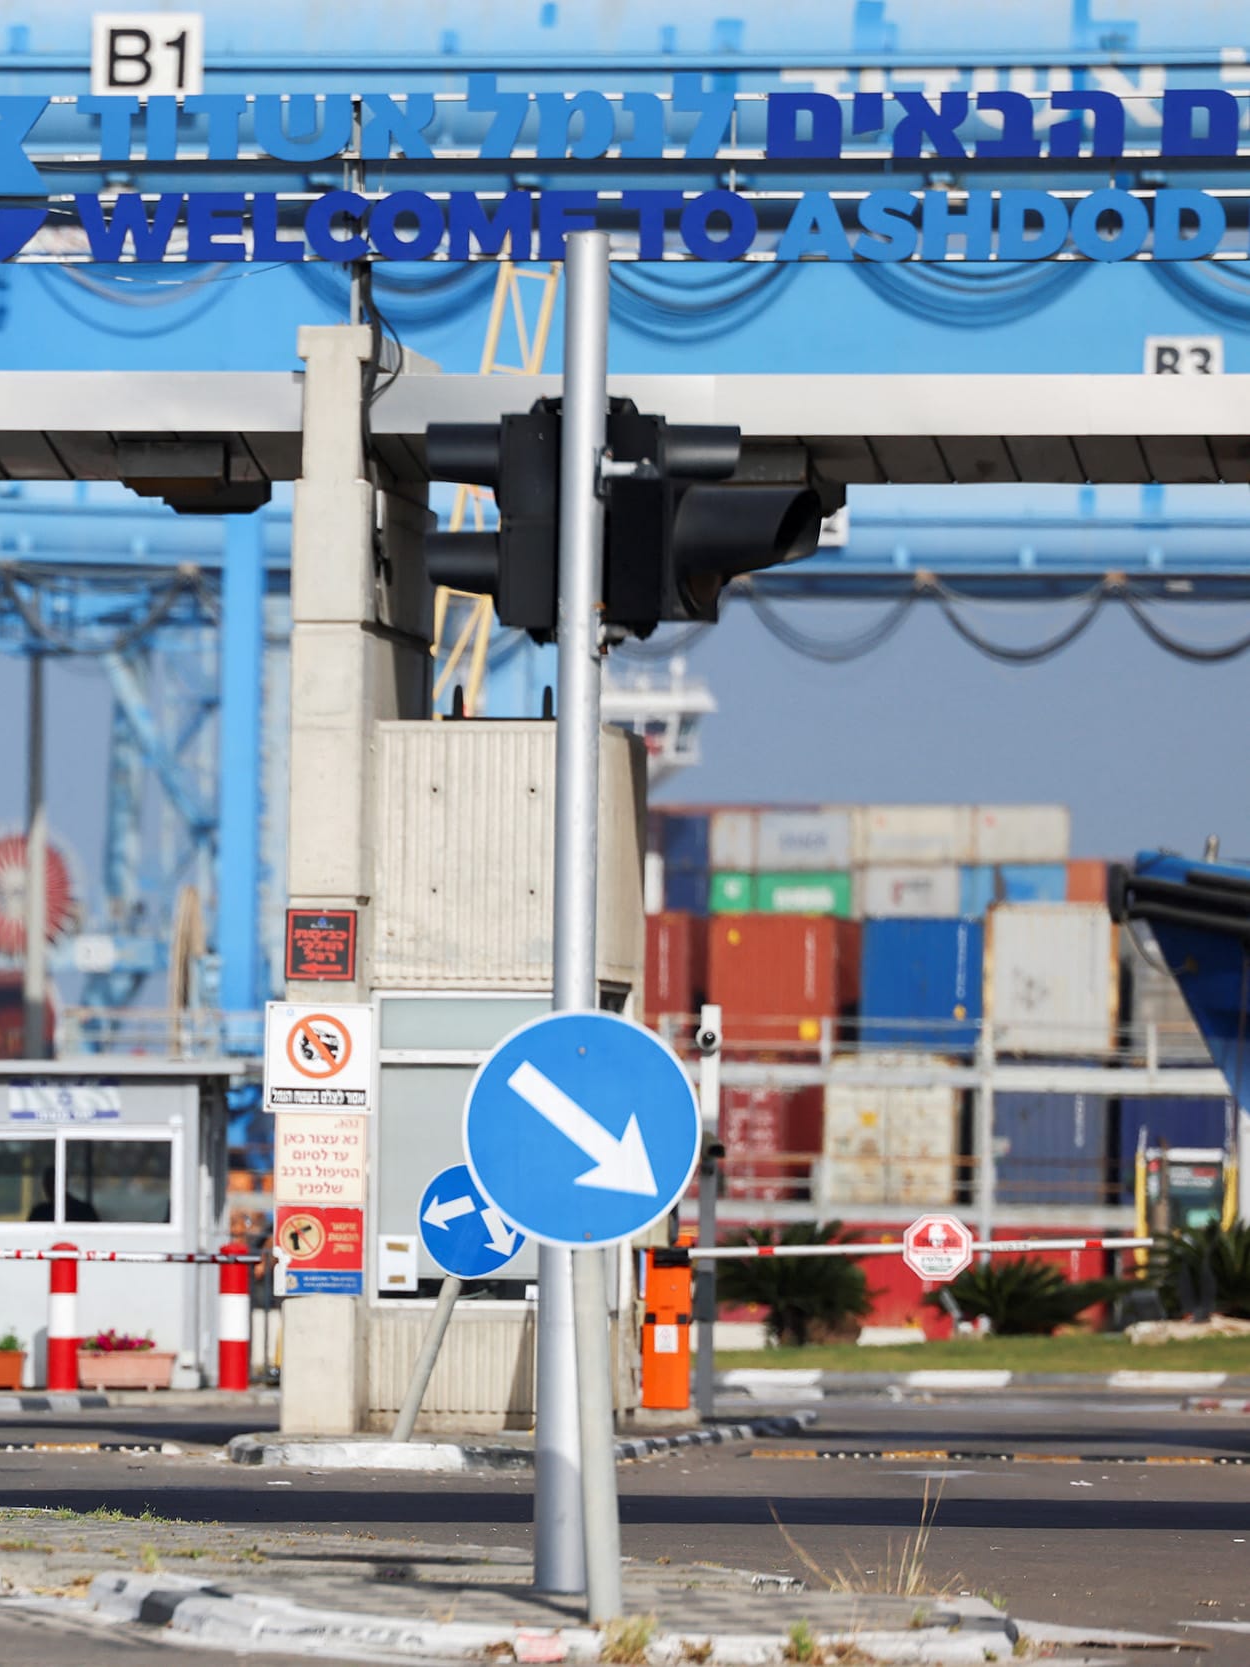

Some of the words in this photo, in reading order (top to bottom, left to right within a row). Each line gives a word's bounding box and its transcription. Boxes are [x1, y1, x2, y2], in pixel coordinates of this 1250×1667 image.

[107, 28, 190, 88] B1
[467, 73, 737, 159] לנמל
[77, 93, 435, 161] אשדוד
[766, 90, 1124, 158] הבאים
[76, 191, 598, 262] WELCOME
[621, 191, 757, 262] TO
[777, 189, 1226, 262] ASHDOD
[1156, 347, 1211, 374] B3
[284, 1134, 305, 1146] כאן
[309, 1134, 339, 1144] עצור
[343, 1135, 358, 1144] נא
[292, 1148, 328, 1160] לסיום
[333, 1151, 349, 1161] עד
[281, 1166, 311, 1176] ברכב
[315, 1165, 359, 1178] הטיפול
[296, 1182, 343, 1196] שלפניך
